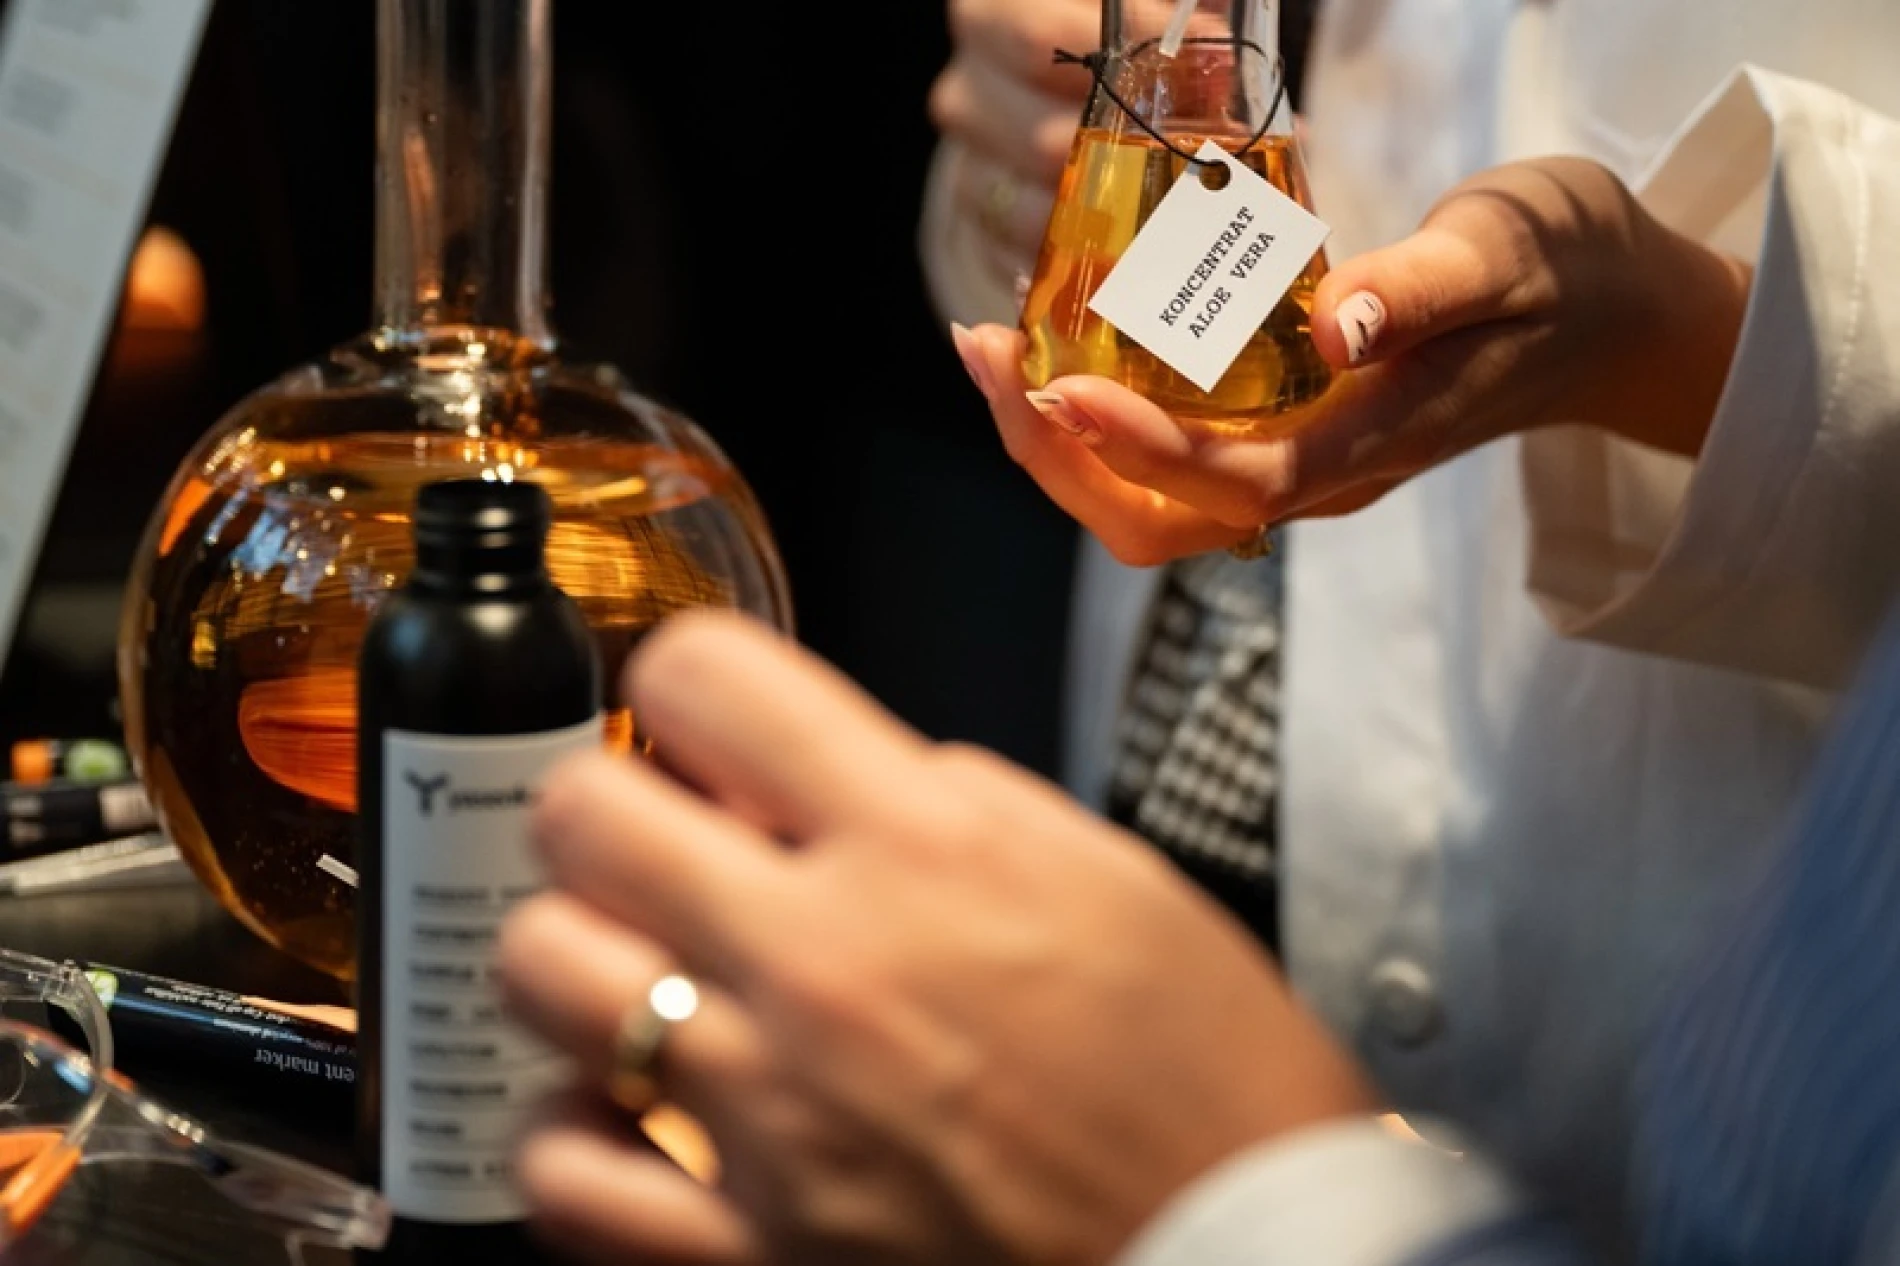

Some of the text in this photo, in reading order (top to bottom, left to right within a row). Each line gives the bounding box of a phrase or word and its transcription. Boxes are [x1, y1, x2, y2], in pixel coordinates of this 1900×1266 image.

[1159, 207, 1254, 326] KONCENTRAT
[1188, 232, 1276, 339] ALOE VERA
[253, 1048, 320, 1076] marker
